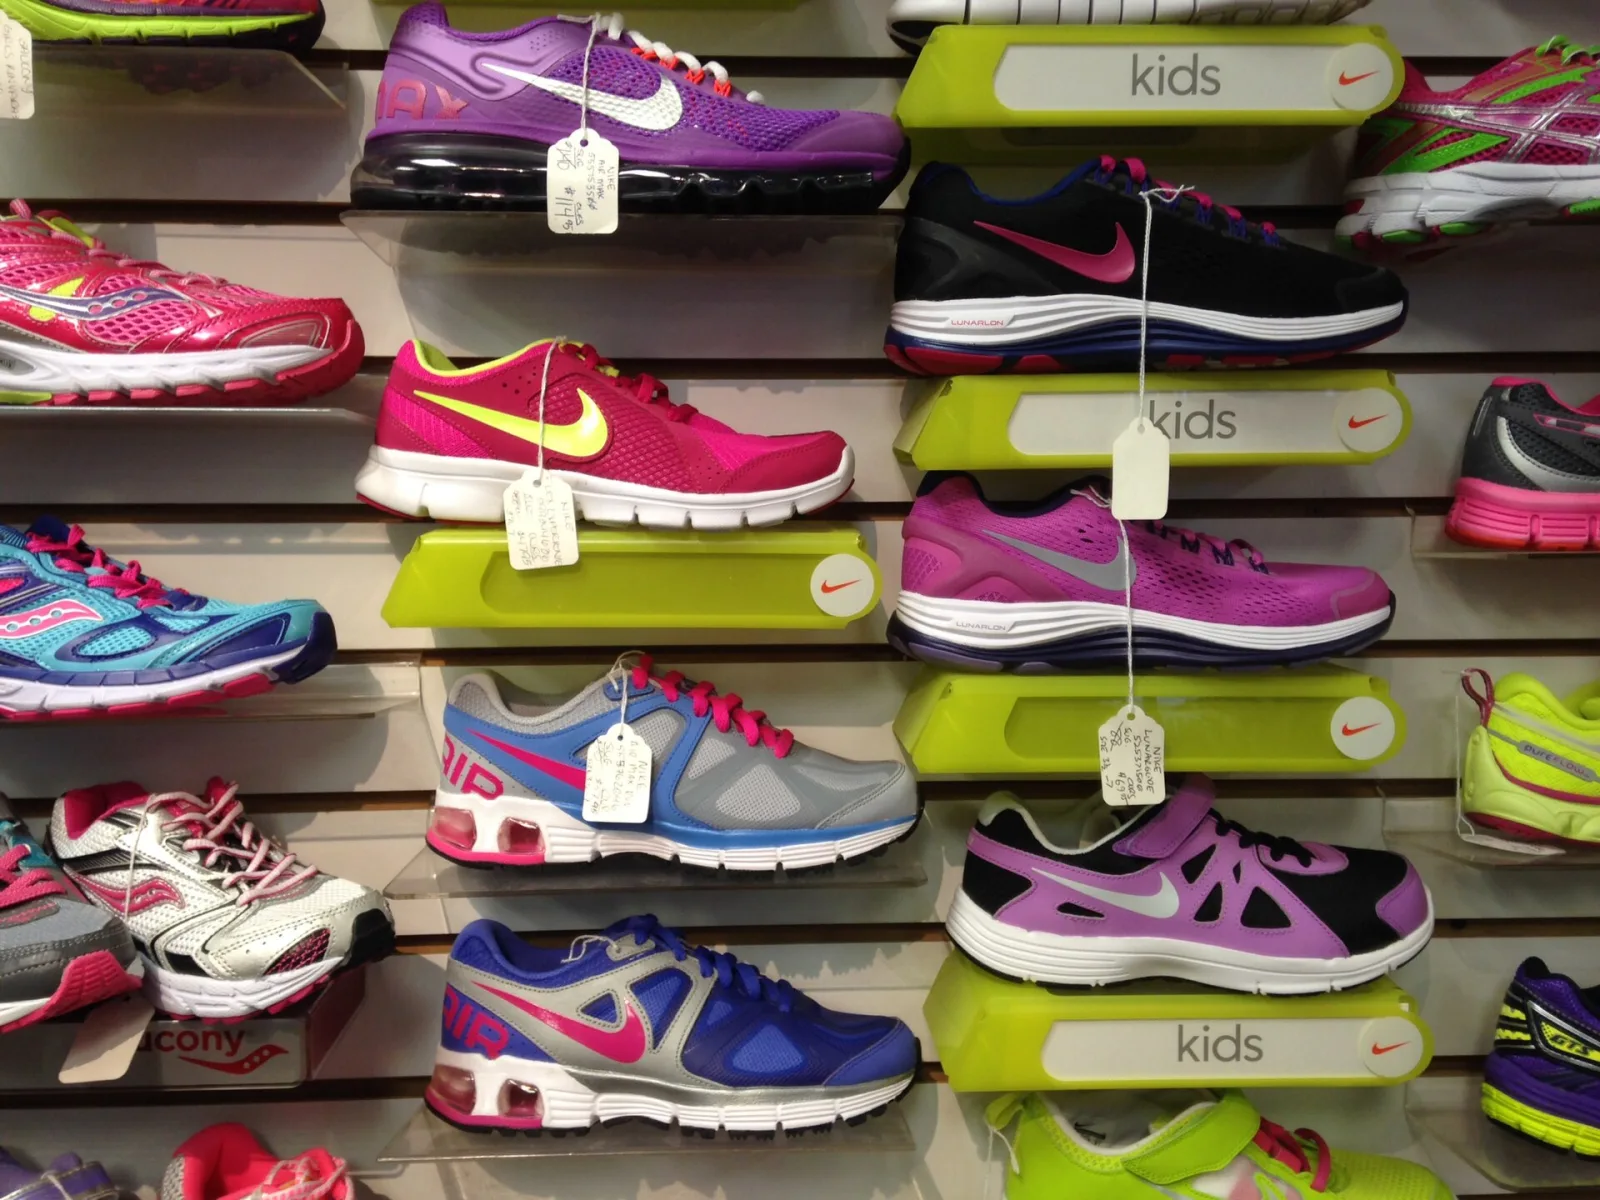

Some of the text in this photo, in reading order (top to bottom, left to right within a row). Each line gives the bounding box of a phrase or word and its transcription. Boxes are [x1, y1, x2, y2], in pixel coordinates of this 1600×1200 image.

[1132, 52, 1221, 96] kids
[597, 159, 606, 175] AIR
[607, 166, 616, 192] NIKE
[1149, 399, 1237, 440] kids
[561, 502, 574, 532] NIKE
[956, 621, 1006, 631] LUNARLON
[1153, 747, 1162, 774] NIKE
[636, 760, 648, 791] NIKE
[1127, 777, 1136, 800] OURS
[1177, 1023, 1264, 1062] kids
